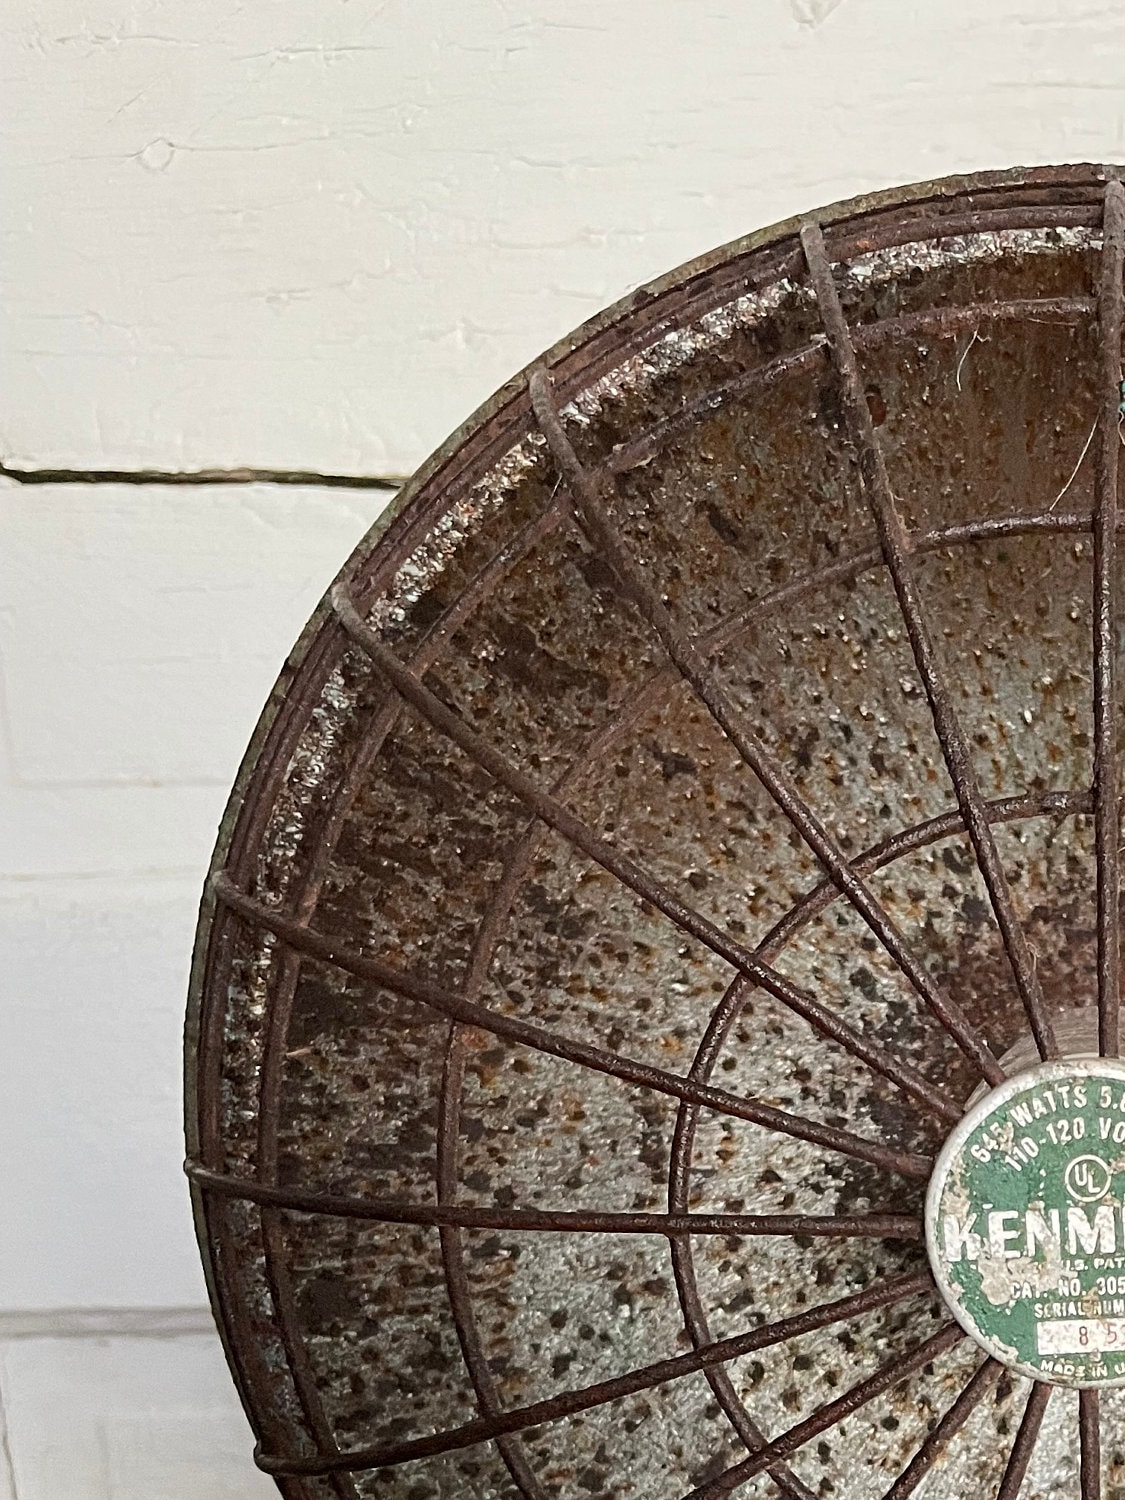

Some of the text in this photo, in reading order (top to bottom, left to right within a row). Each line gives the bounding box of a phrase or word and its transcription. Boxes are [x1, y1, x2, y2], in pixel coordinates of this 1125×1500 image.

[1009, 1086, 1087, 1127] WATTS
[1075, 1163, 1101, 1193] UL
[1059, 1278, 1087, 1297] NO.
[1034, 1301, 1086, 1318] SERIAL
[1040, 1360, 1086, 1377] MADE
[1092, 1362, 1108, 1377] IN
